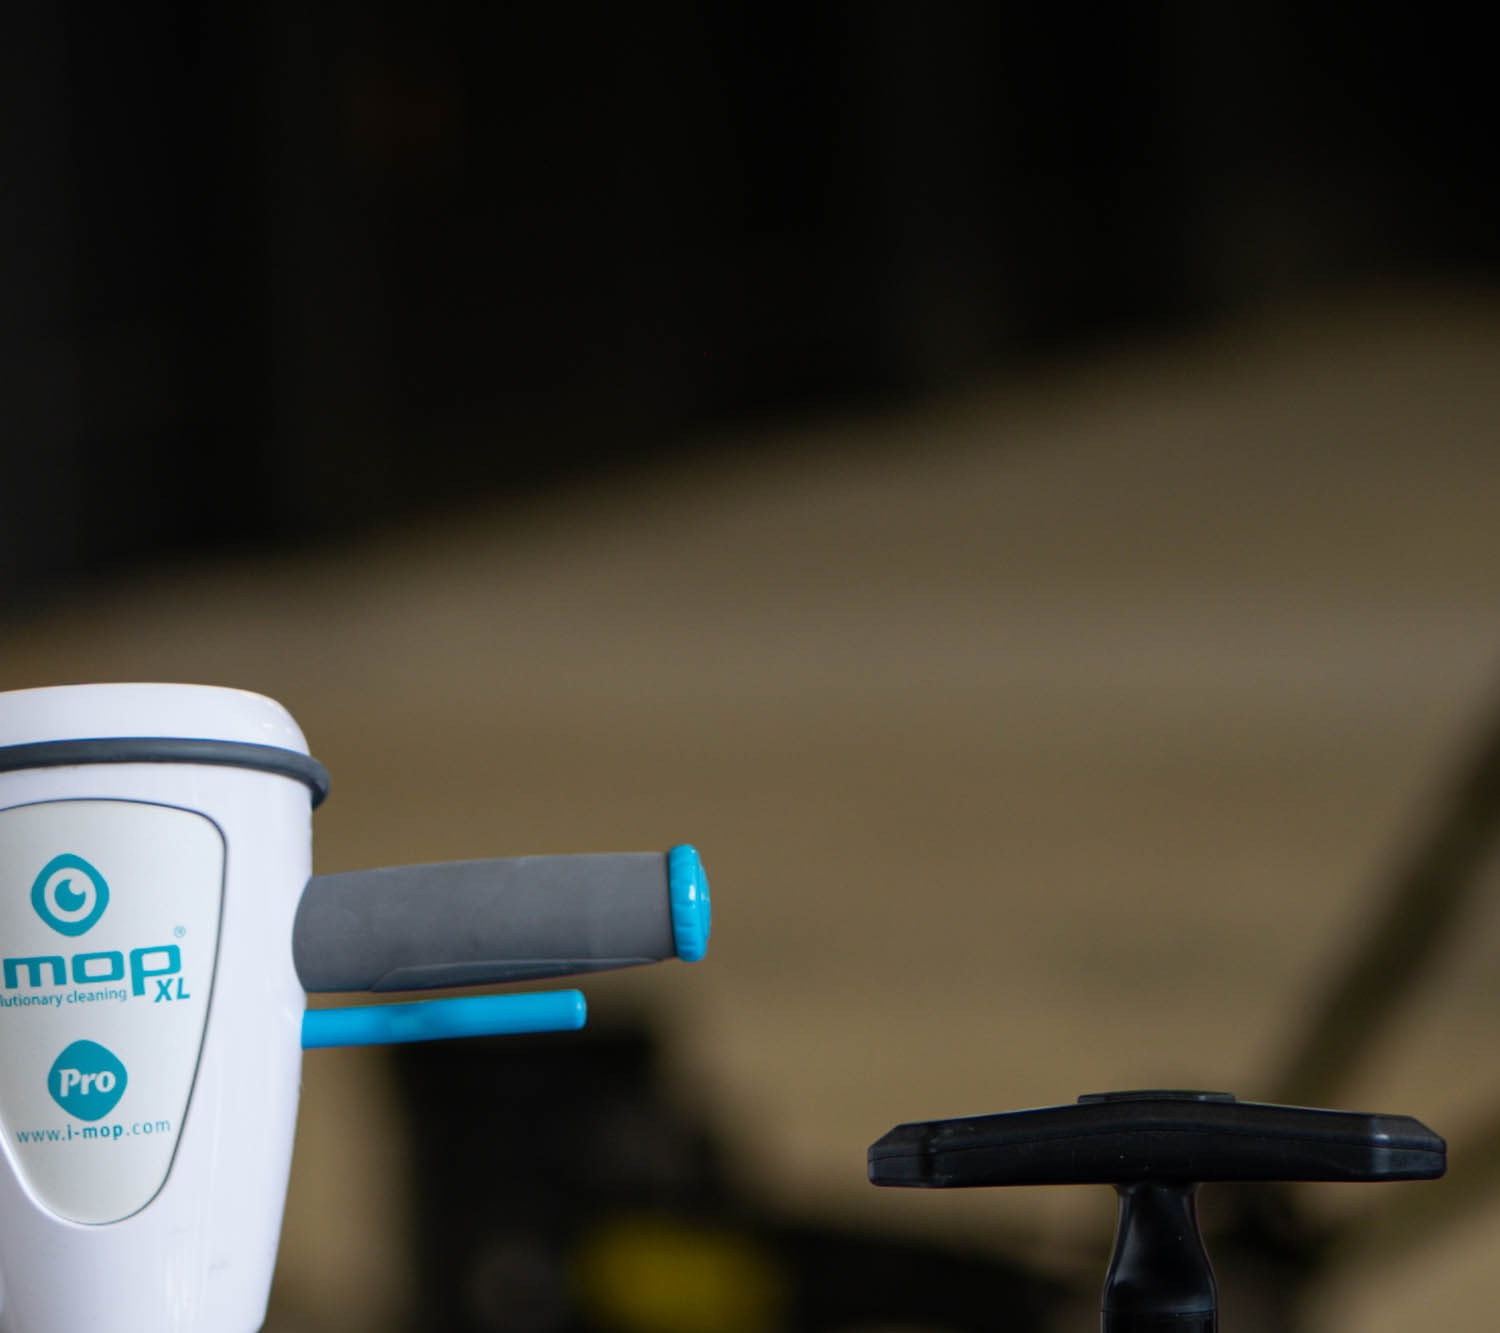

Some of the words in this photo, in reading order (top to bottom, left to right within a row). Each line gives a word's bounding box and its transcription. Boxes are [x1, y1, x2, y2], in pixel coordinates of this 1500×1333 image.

[66, 986, 127, 1005] cleaning
[153, 977, 191, 1003] XL
[58, 1068, 116, 1097] Pro
[15, 1119, 171, 1144] www.i-mop.com
